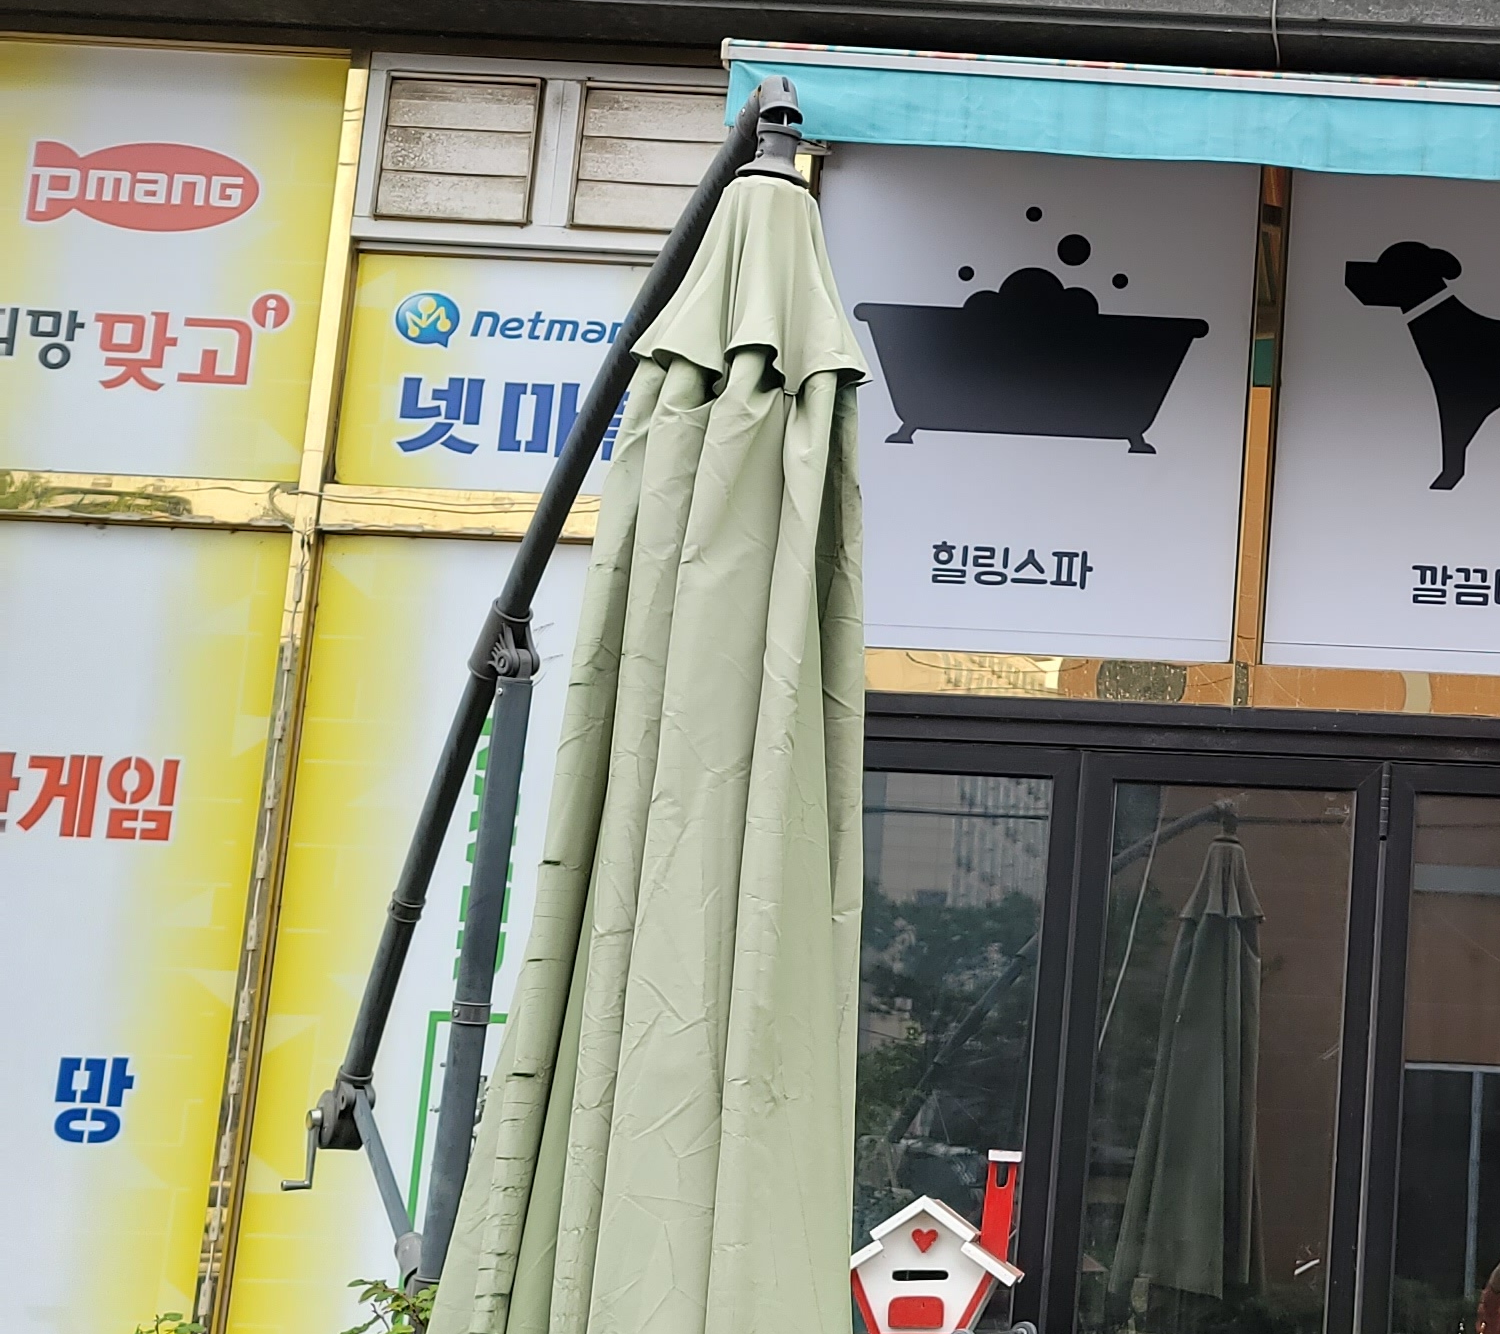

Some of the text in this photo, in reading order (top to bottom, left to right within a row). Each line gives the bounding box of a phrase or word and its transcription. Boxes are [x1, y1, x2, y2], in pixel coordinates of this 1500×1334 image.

[94, 310, 254, 392] 맞고
[396, 376, 630, 462] 넷마
[931, 540, 1093, 591] 힐링스파
[54, 1057, 135, 1144] 망
